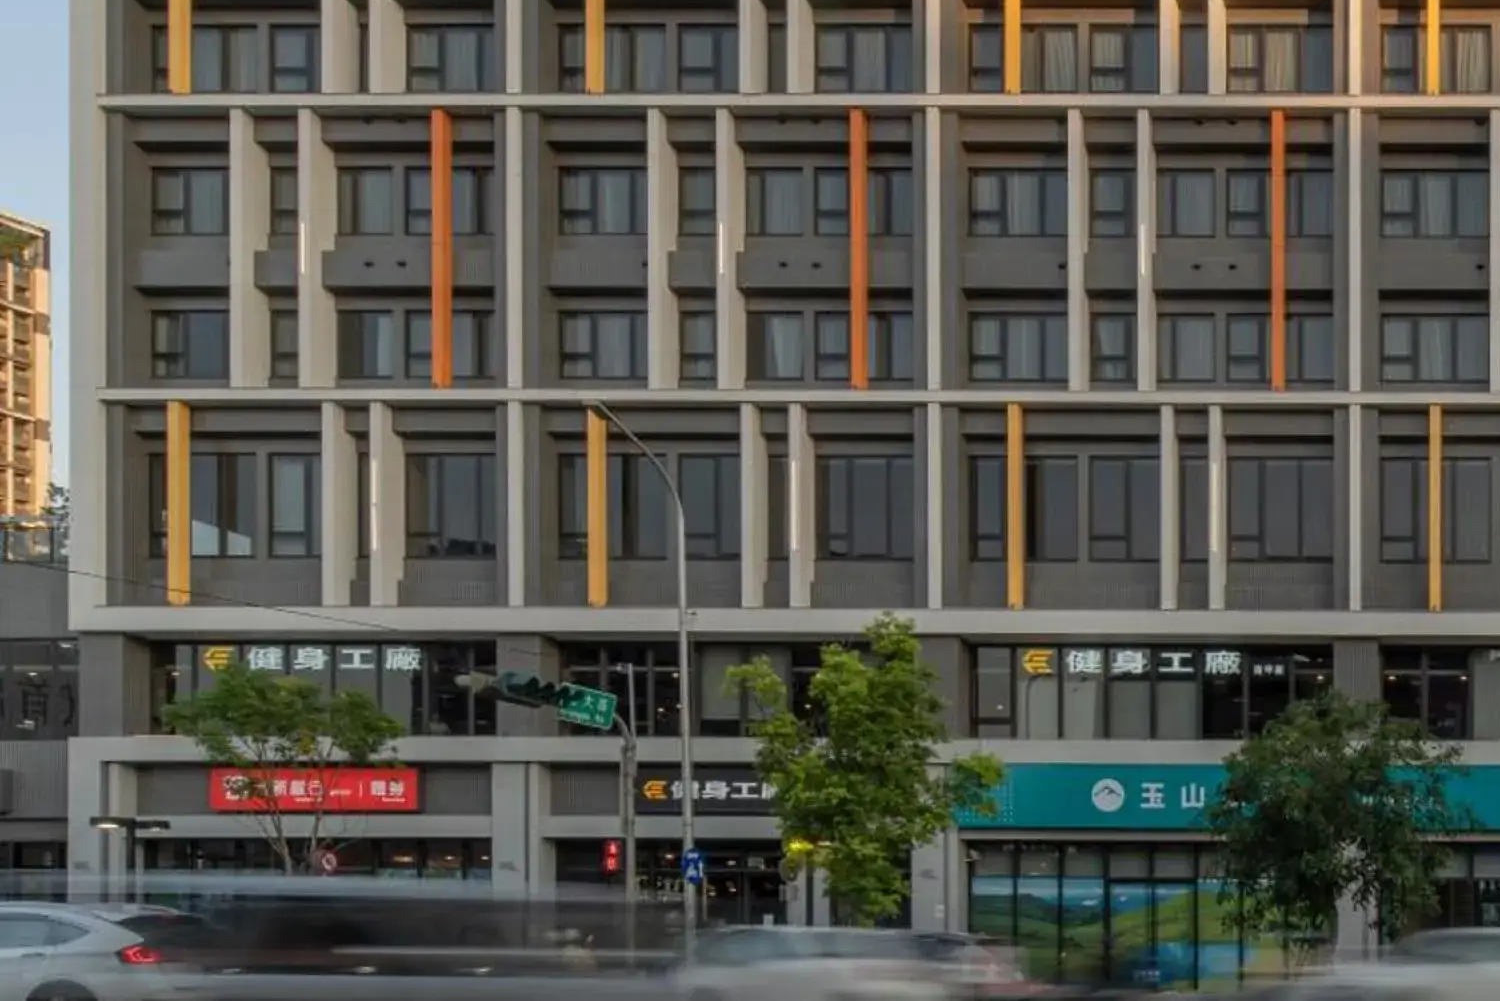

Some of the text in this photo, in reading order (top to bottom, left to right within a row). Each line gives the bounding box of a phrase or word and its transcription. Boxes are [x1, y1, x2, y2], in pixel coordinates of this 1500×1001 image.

[249, 646, 422, 671] 健身工廠
[1066, 649, 1242, 675] 健身工廠
